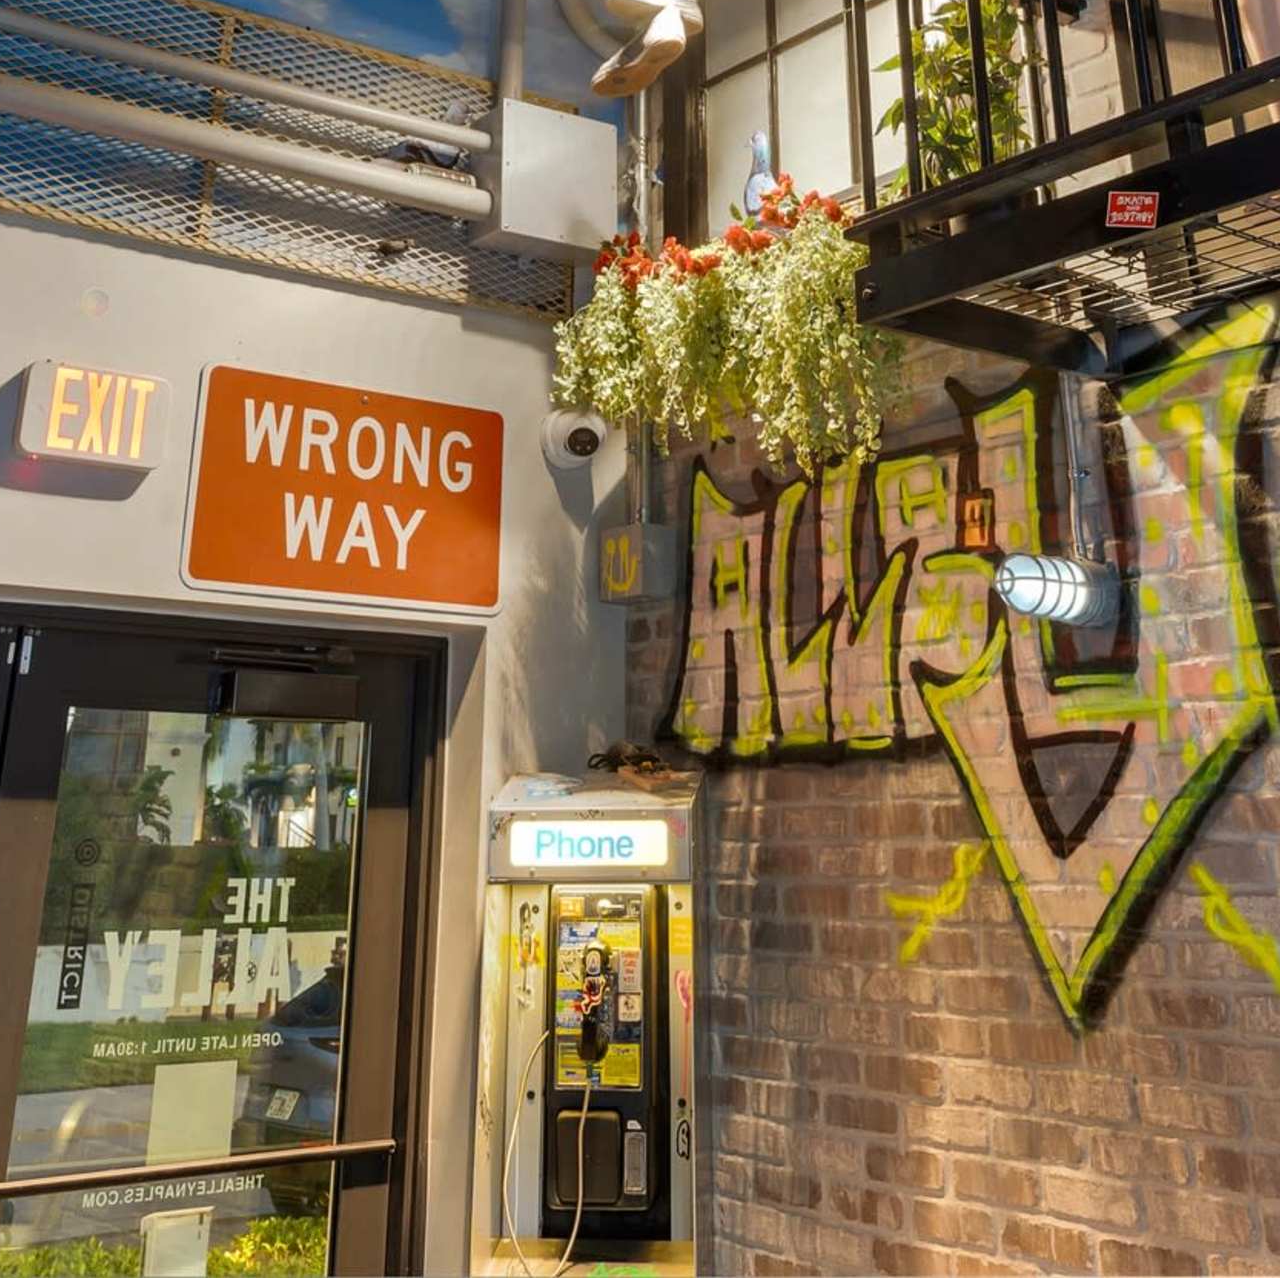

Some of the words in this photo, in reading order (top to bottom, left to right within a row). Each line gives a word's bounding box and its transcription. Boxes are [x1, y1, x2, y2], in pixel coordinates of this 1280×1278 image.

[45, 367, 155, 460] EXIT
[242, 397, 474, 493] WRONG
[281, 492, 427, 571] WAY
[535, 828, 634, 860] Phone
